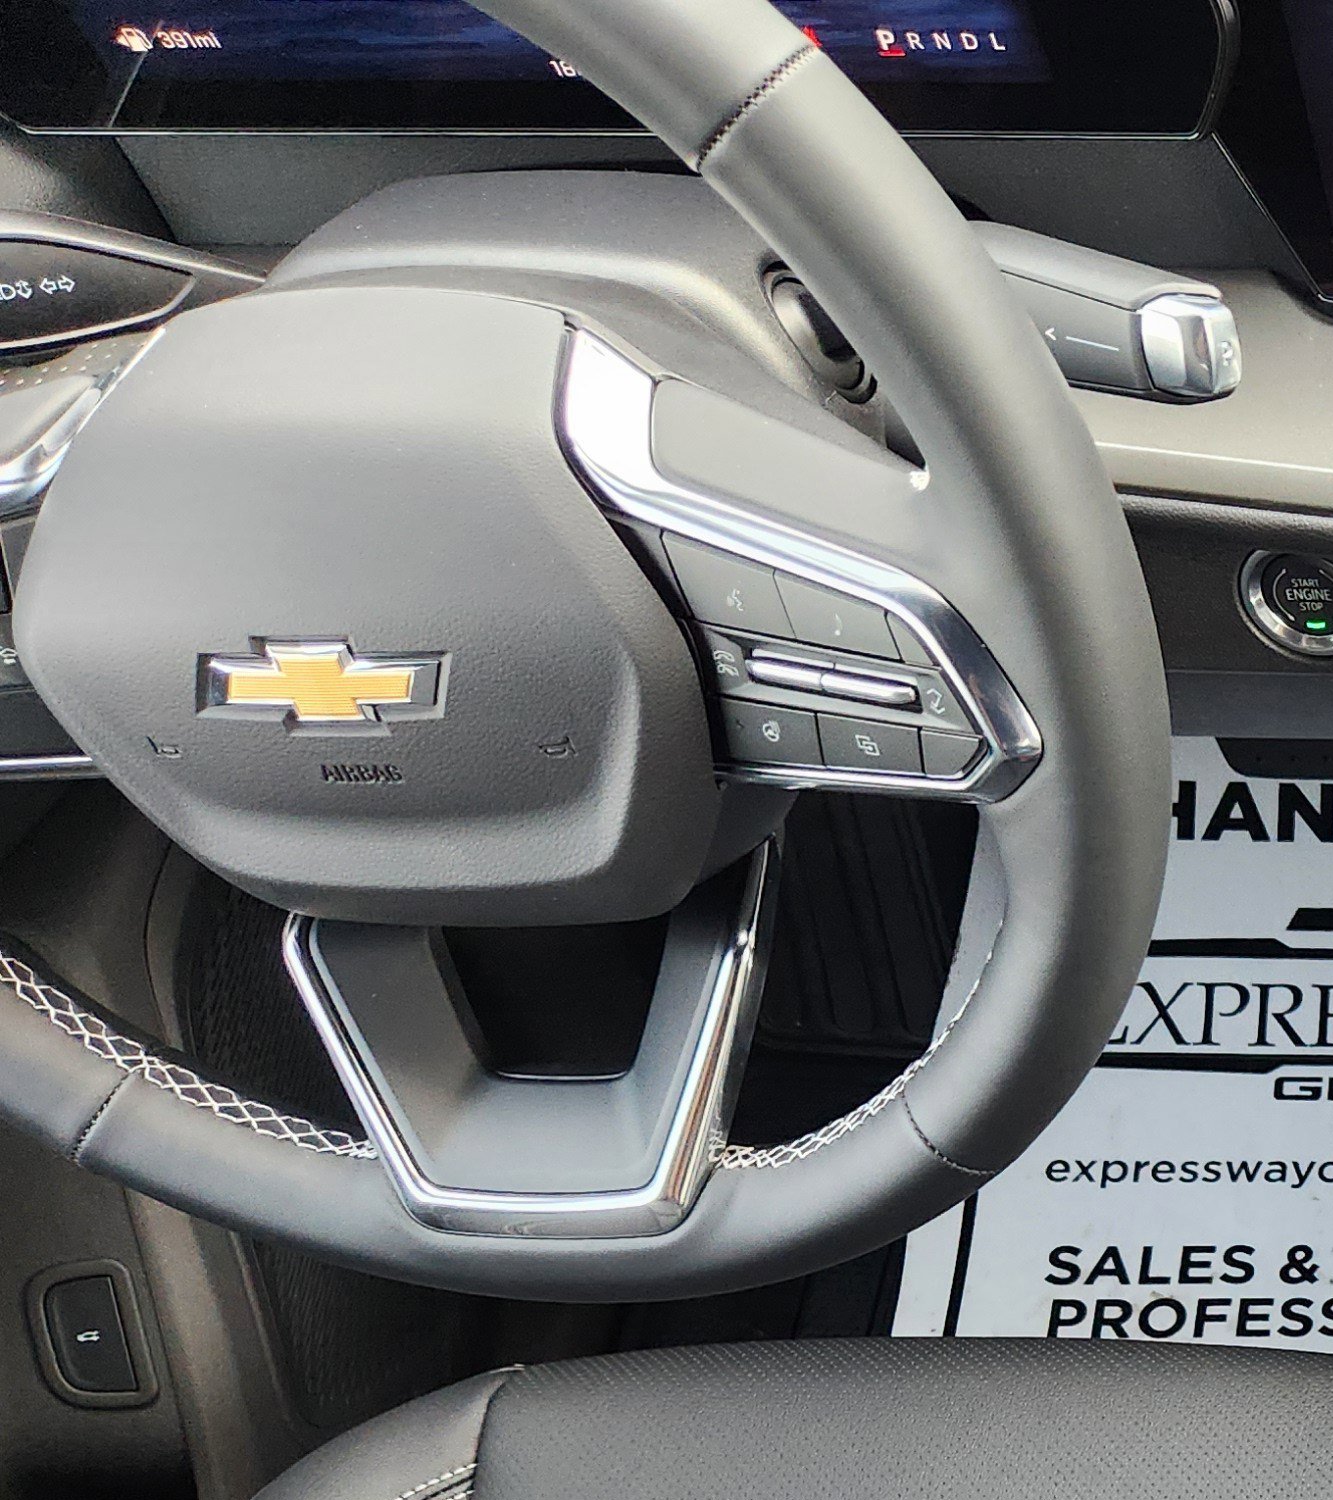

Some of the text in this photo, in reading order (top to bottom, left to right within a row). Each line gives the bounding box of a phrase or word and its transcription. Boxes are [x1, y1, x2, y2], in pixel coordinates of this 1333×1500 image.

[156, 29, 222, 49] 391mi
[876, 28, 1006, 51] P R N D L
[1290, 578, 1320, 588] START
[1285, 588, 1333, 602] ENGINE
[1299, 602, 1324, 612] STOP
[320, 763, 404, 784] AIRBAG
[1044, 1243, 1256, 1286] SALES
[1279, 1243, 1321, 1286] &
